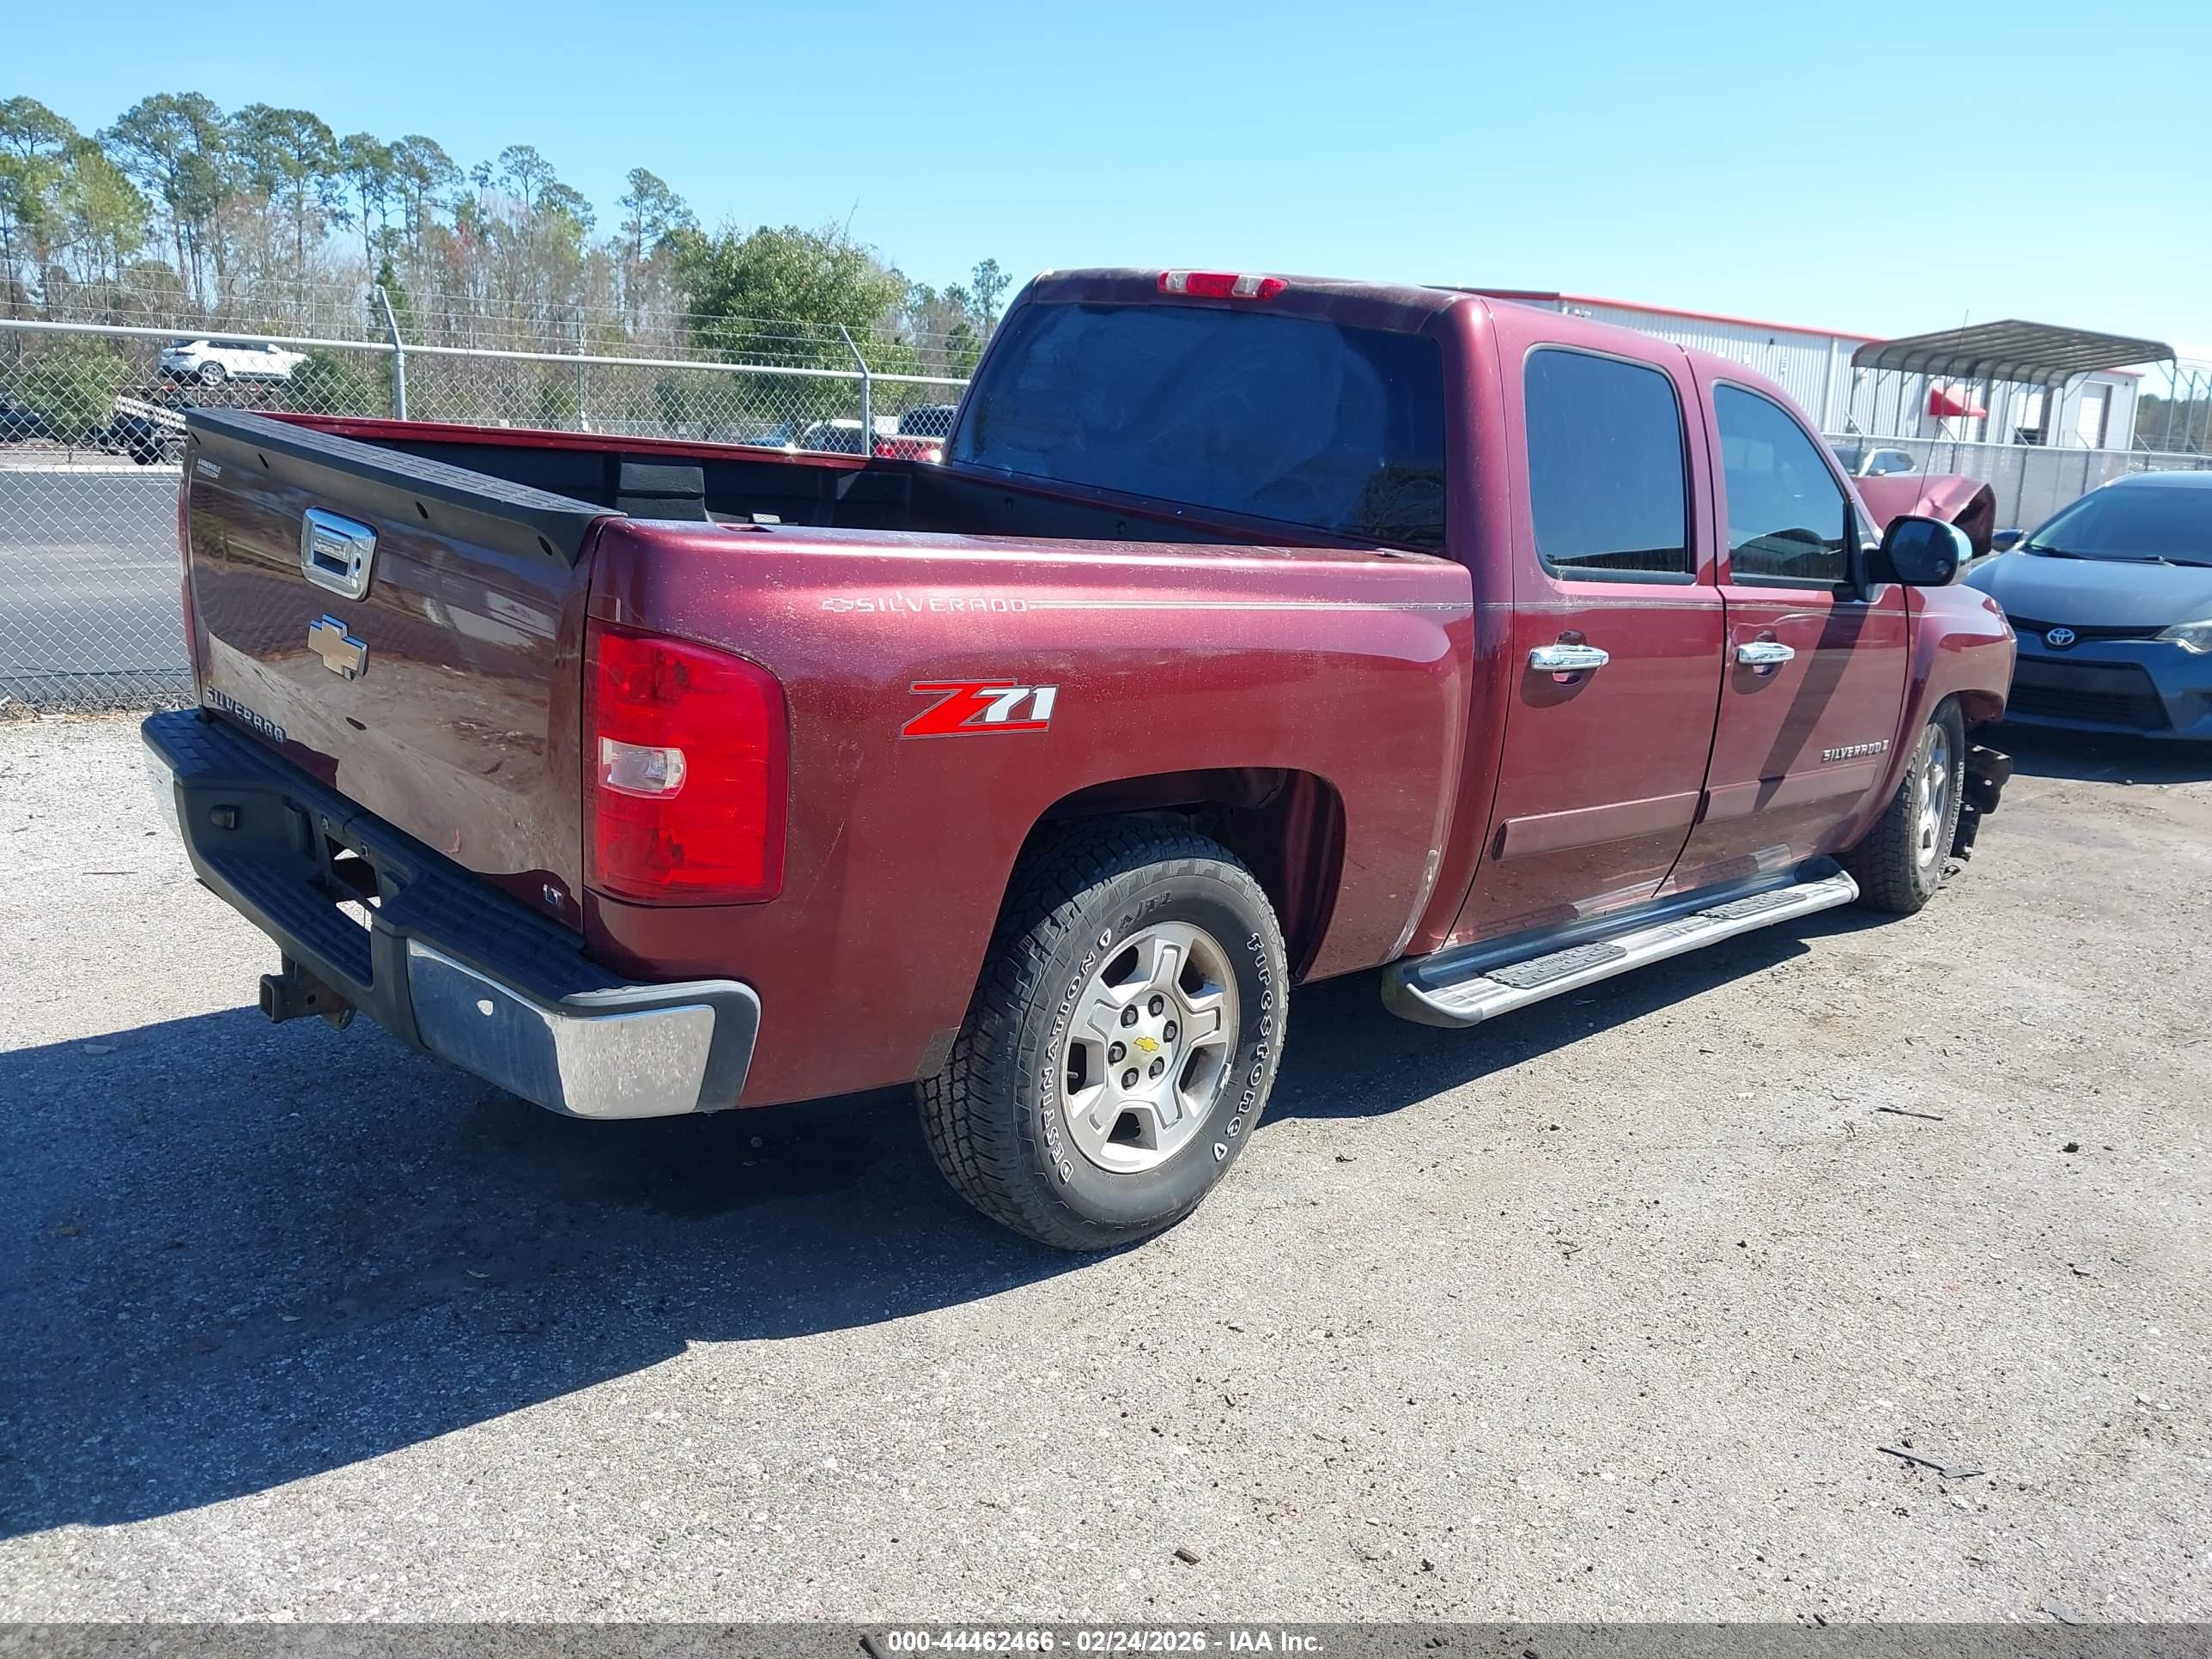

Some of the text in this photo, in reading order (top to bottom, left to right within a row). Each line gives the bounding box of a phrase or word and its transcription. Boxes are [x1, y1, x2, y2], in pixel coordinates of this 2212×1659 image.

[858, 598, 1027, 612] SILVERADO
[206, 686, 287, 743] SILVERADO
[900, 678, 1059, 740] Z71
[1822, 741, 1881, 762] SILVERADO
[543, 884, 562, 906] LT
[1040, 953, 1096, 1185] DESTINATION
